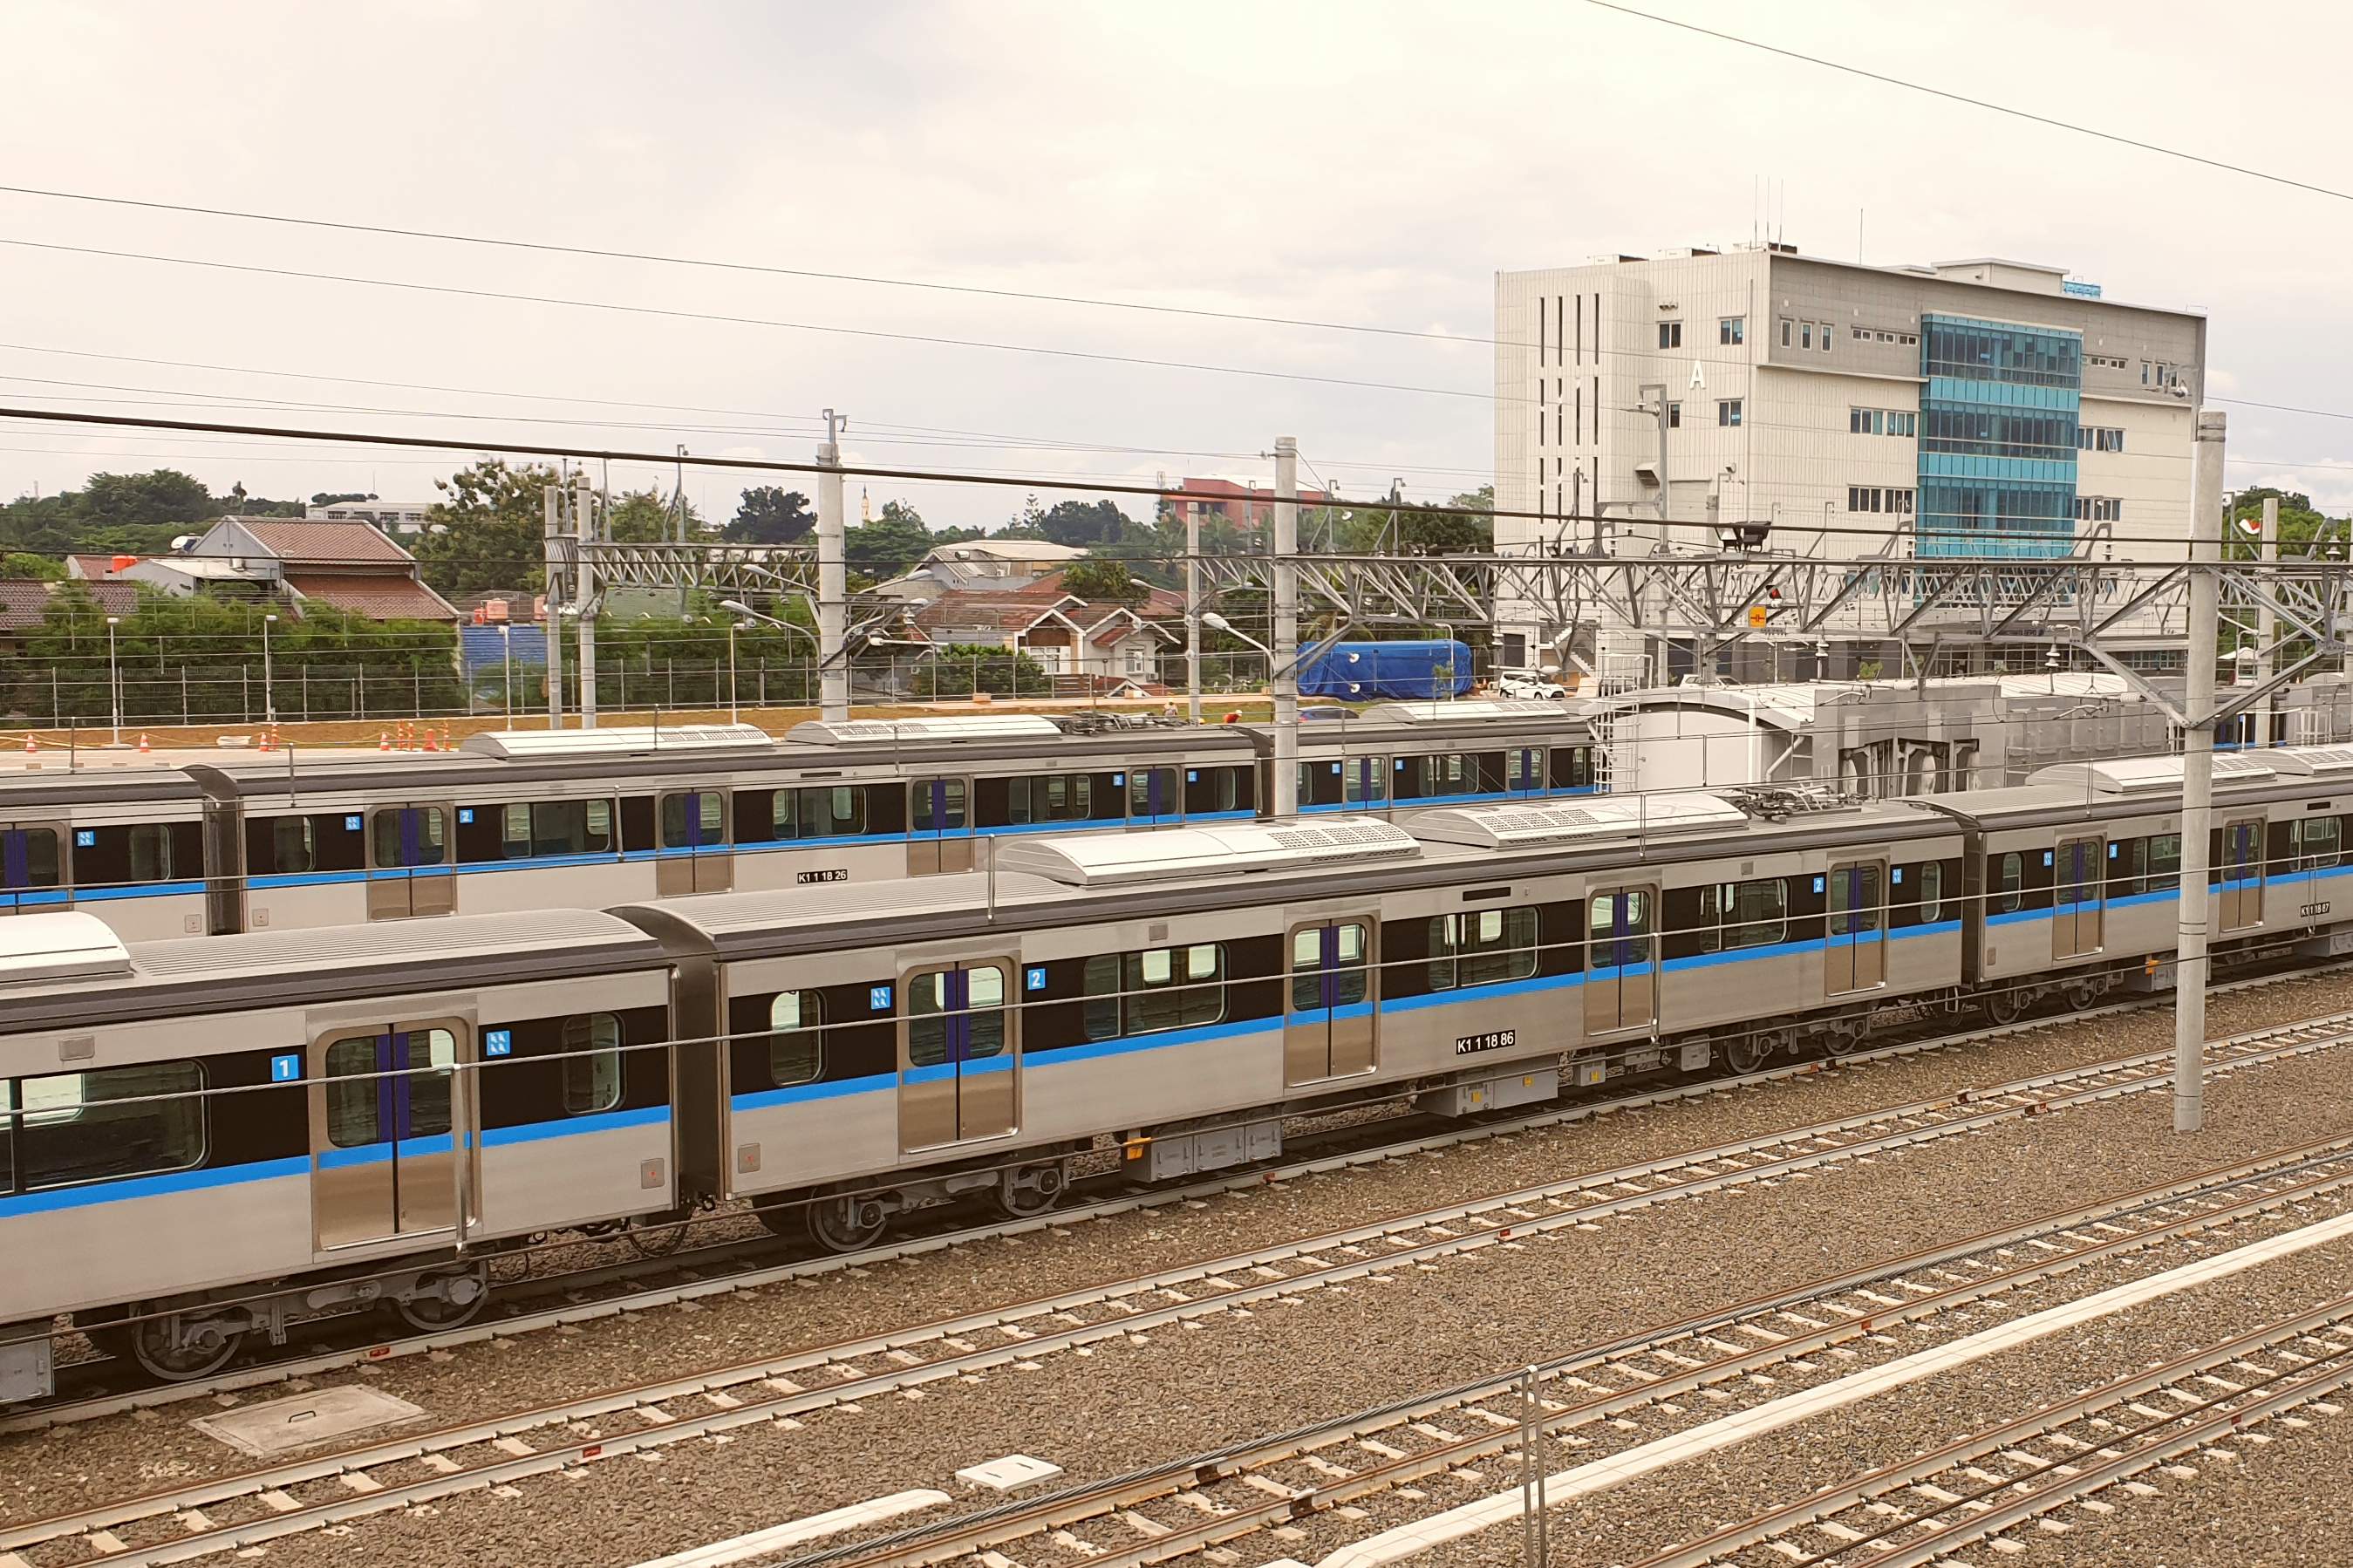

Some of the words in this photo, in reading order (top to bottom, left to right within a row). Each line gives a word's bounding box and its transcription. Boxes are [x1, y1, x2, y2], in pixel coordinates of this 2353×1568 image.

[1689, 360, 1707, 390] A
[462, 811, 469, 821] 2
[798, 873, 810, 883] K1
[822, 872, 833, 881] 18
[835, 870, 846, 879] 26
[1816, 879, 1822, 890] 2
[1032, 972, 1040, 987] 2
[1457, 1039, 1471, 1053] K1
[1476, 1037, 1481, 1050] 1
[1485, 1034, 1498, 1048] 18
[1500, 1032, 1514, 1046] 86
[279, 1060, 289, 1077] 1
